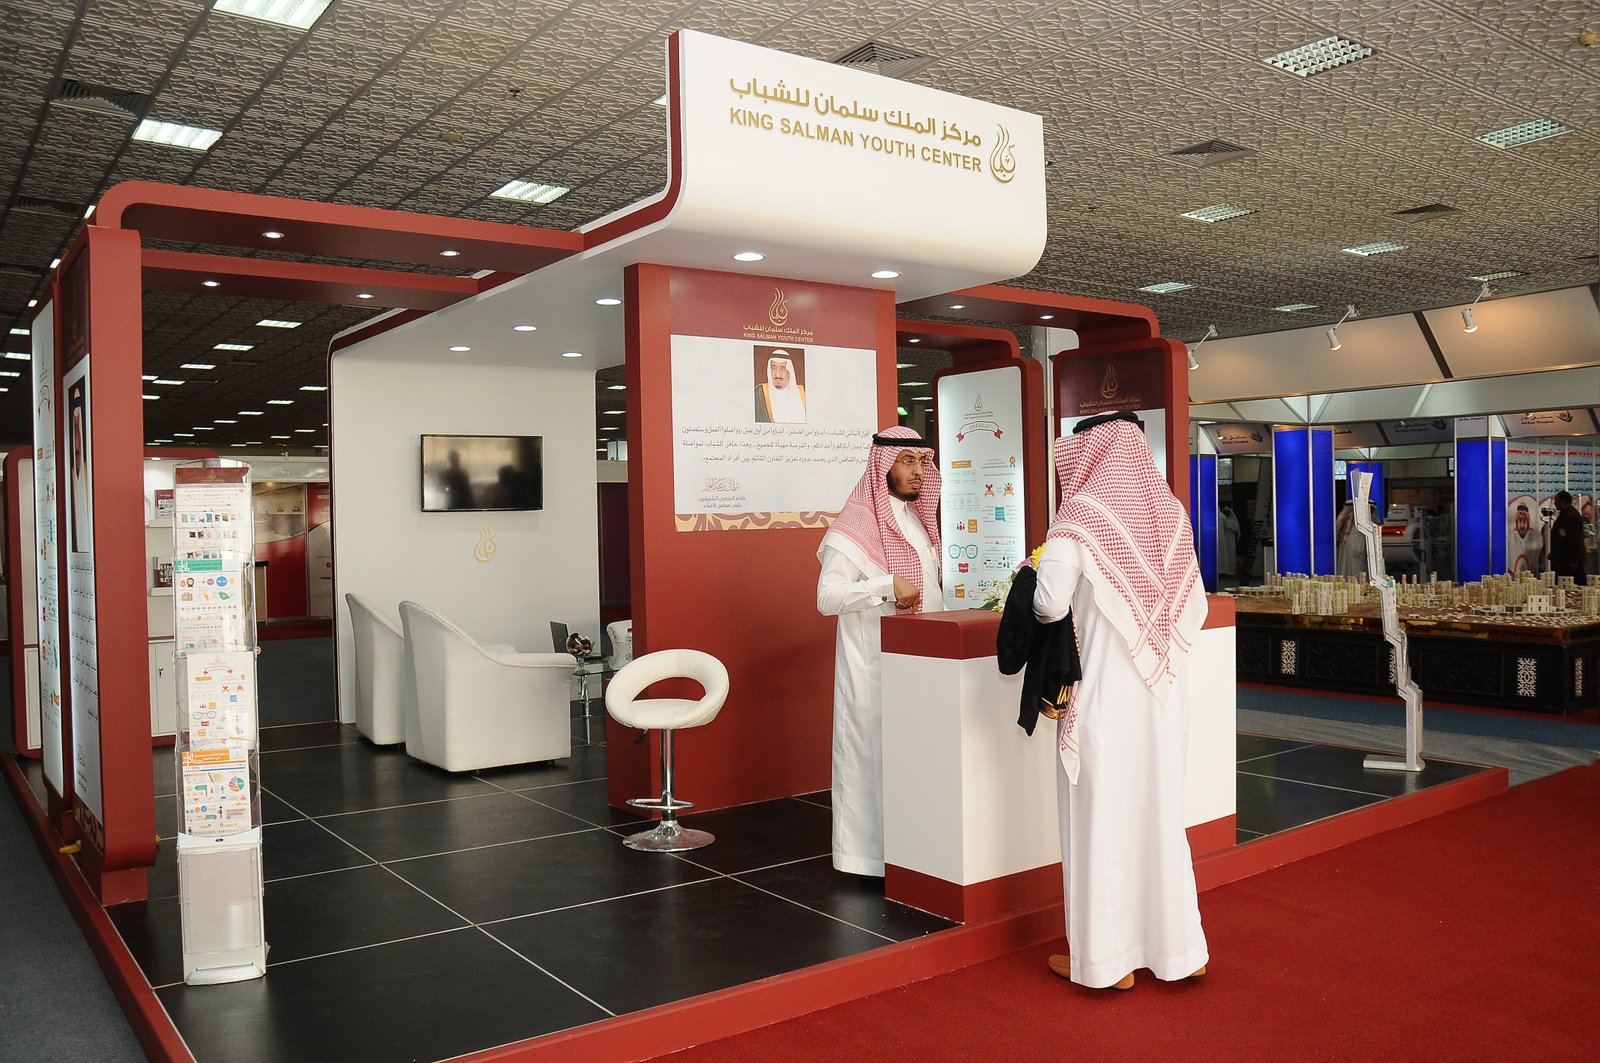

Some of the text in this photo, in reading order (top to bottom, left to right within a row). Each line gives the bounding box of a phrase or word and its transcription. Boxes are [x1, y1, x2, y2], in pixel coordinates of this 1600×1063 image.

[729, 77, 982, 147] مركز الملك سلمان للشباب
[729, 107, 982, 173] KING SALMAN YOUTH CENTER
[742, 323, 765, 332] للشباب
[765, 325, 783, 333] سلمان
[800, 328, 813, 336] مركز
